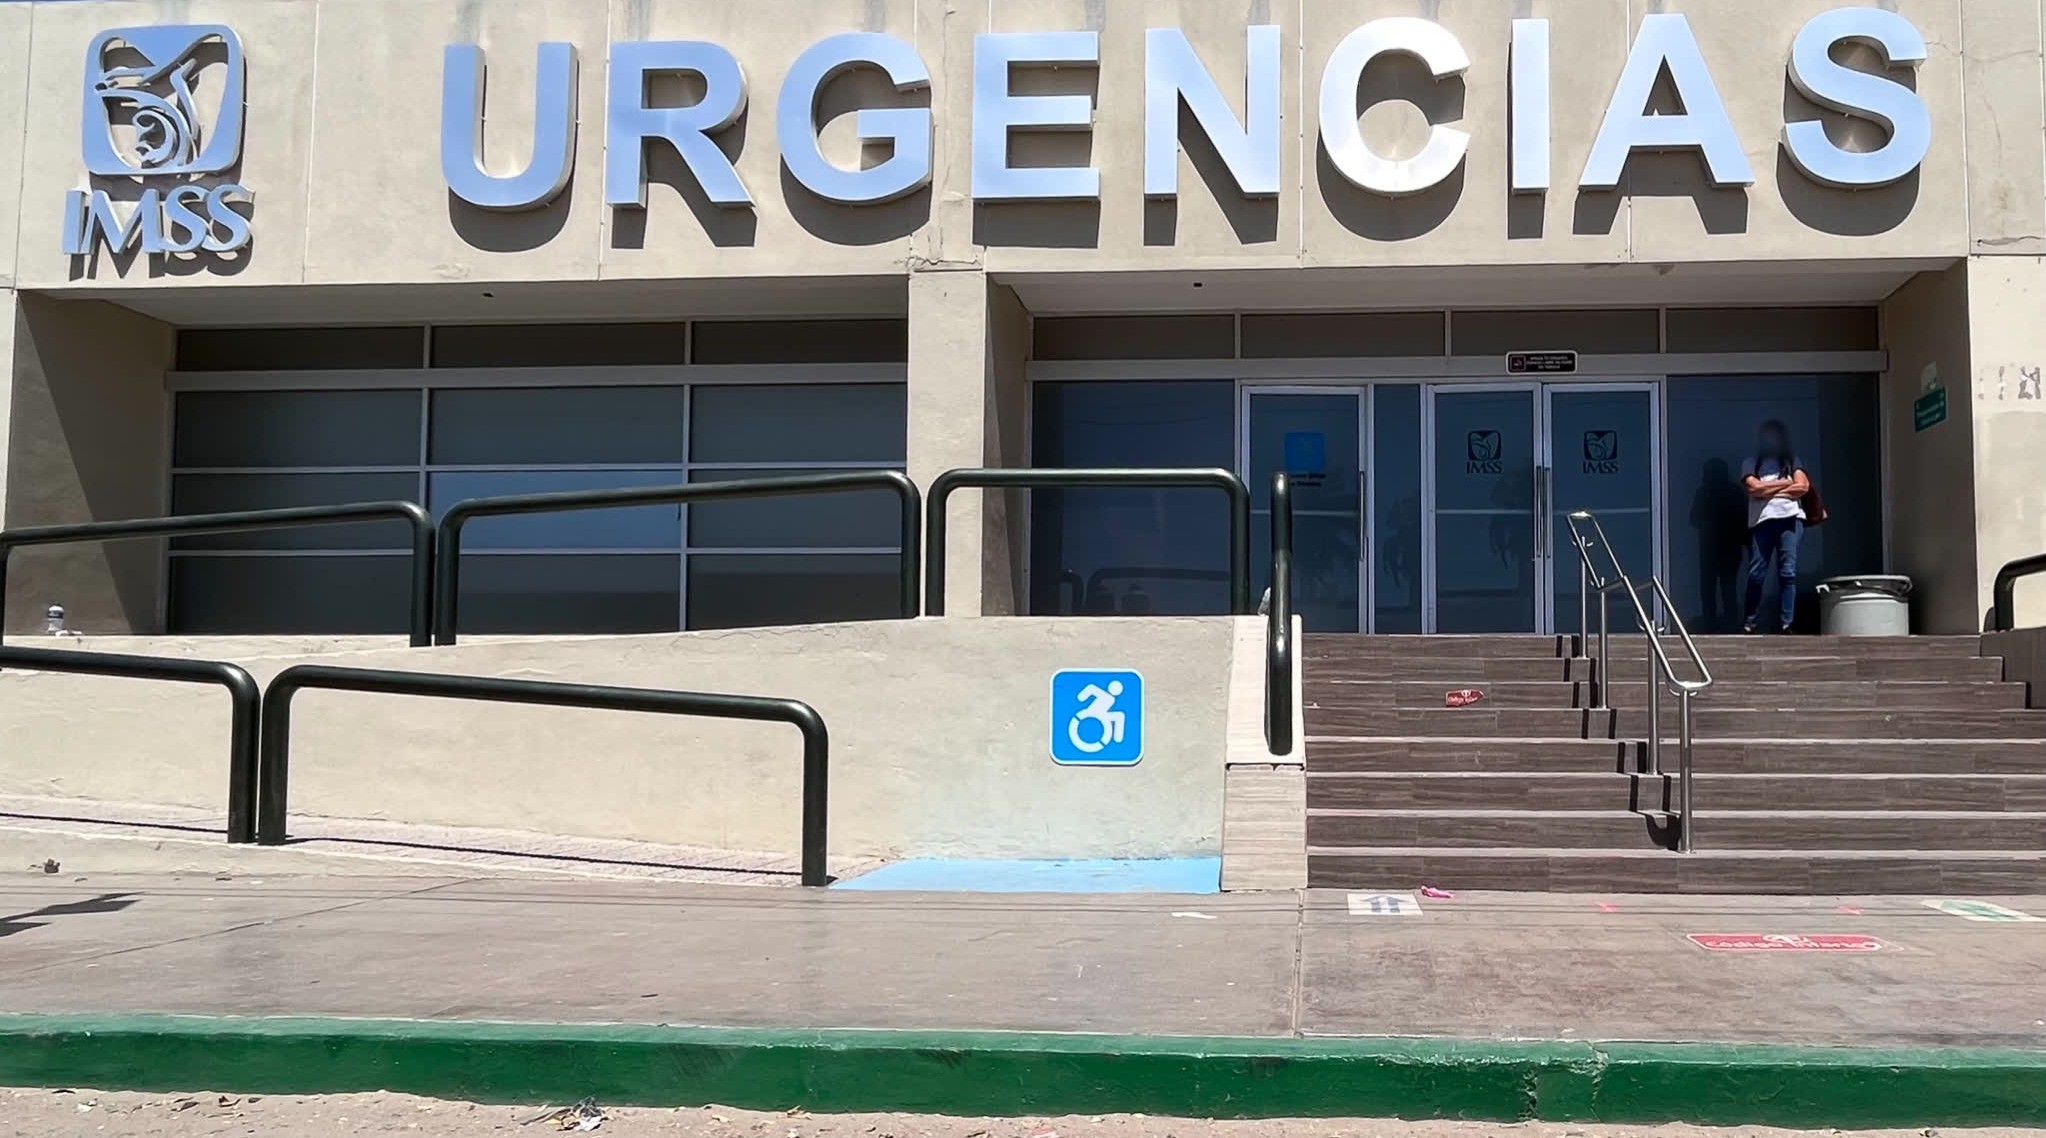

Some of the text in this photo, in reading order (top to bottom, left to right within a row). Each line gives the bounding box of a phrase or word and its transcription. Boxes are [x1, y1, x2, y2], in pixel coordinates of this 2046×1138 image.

[441, 6, 1932, 209] URGENCIAS
[63, 184, 256, 255] IMSS
[1466, 461, 1503, 474] IMSS
[1583, 461, 1619, 474] IMSS
